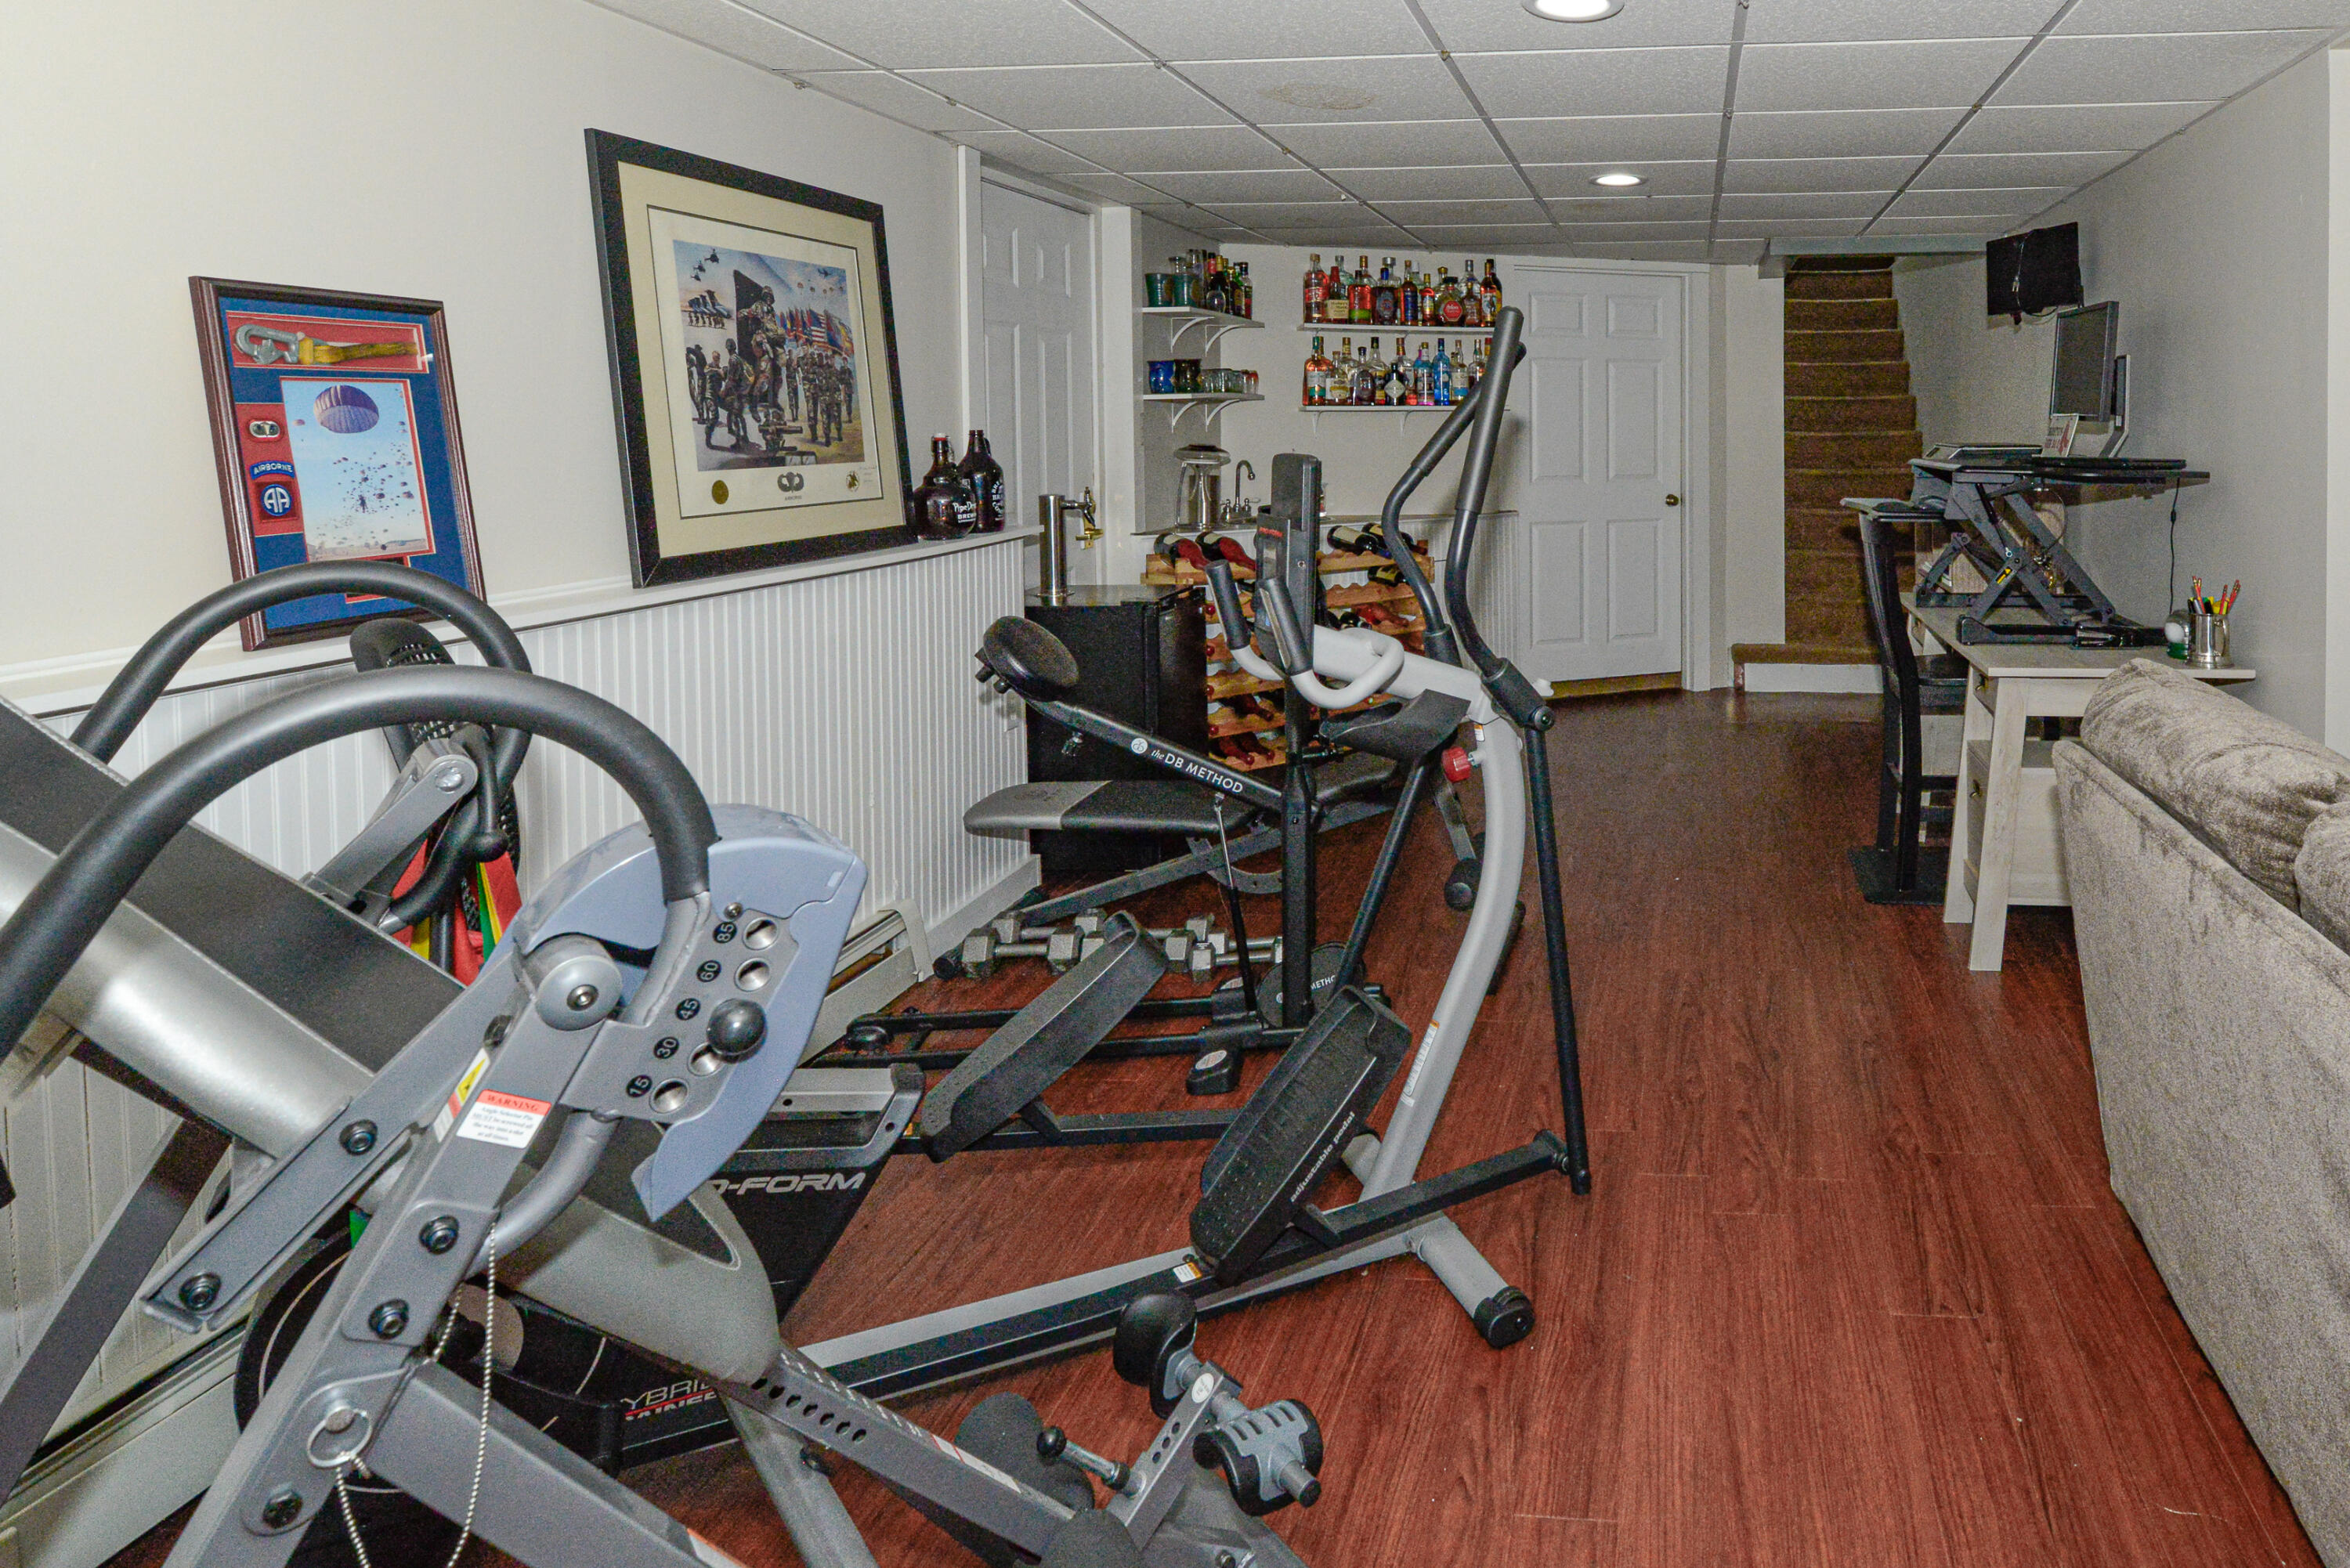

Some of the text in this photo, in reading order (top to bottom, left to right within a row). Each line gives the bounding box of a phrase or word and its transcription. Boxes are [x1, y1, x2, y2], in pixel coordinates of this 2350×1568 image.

[254, 463, 293, 475] AIRBORNE
[263, 487, 291, 513] AA
[1151, 749, 1244, 793] the DB METHOD
[716, 922, 734, 942] 85
[702, 962, 719, 981] 60
[682, 1000, 699, 1021] 45
[656, 1039, 677, 1059] 30
[629, 1077, 650, 1097] 15
[487, 1094, 538, 1112] WARNING
[1290, 1111, 1356, 1203] adjustable pedal
[620, 1378, 710, 1410] YBRI
